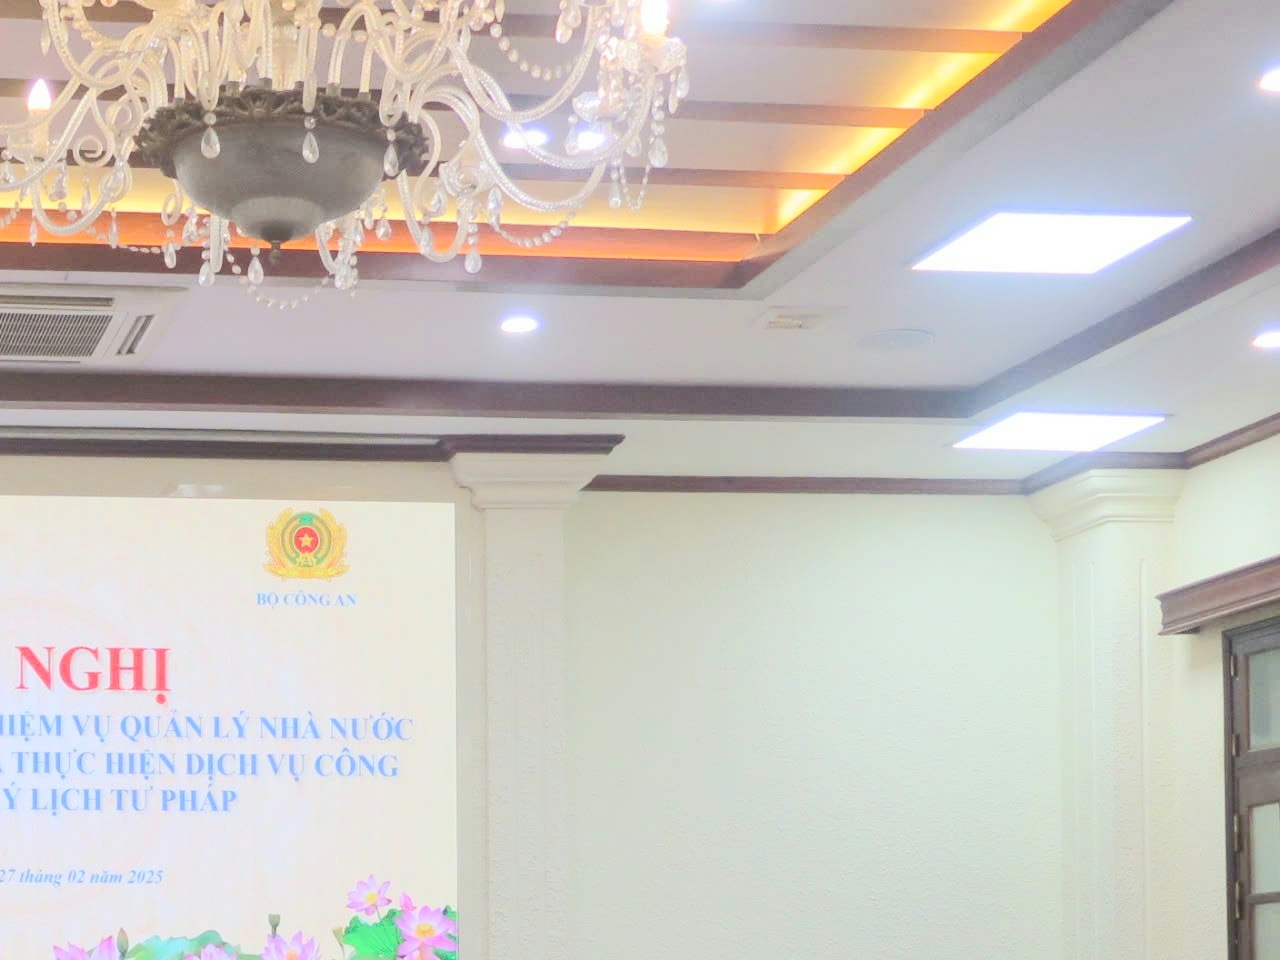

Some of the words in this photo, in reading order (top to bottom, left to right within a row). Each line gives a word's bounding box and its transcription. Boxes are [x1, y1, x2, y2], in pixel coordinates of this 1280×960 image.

[256, 591, 279, 608] BỘ
[283, 589, 330, 606] CÔNG
[335, 593, 357, 607] AN
[15, 646, 172, 705] NGHỊ
[71, 714, 111, 743] VỤ
[120, 708, 203, 742] QUẢN
[212, 710, 250, 739] LÝ
[259, 711, 321, 740] NHÀ
[329, 711, 414, 741] NƯỚC
[11, 748, 97, 780] THỰC
[105, 749, 176, 781] HIỆN
[185, 752, 258, 781] DỊCH
[267, 753, 306, 782] VỤ
[314, 747, 399, 777] CÔNG
[30, 788, 102, 816] LỊCH
[110, 785, 154, 812] TƯ
[161, 783, 237, 812] PHÁP
[19, 868, 63, 887] tháng
[67, 869, 85, 884] 02
[90, 869, 123, 884] năm
[128, 869, 165, 884] 2025
